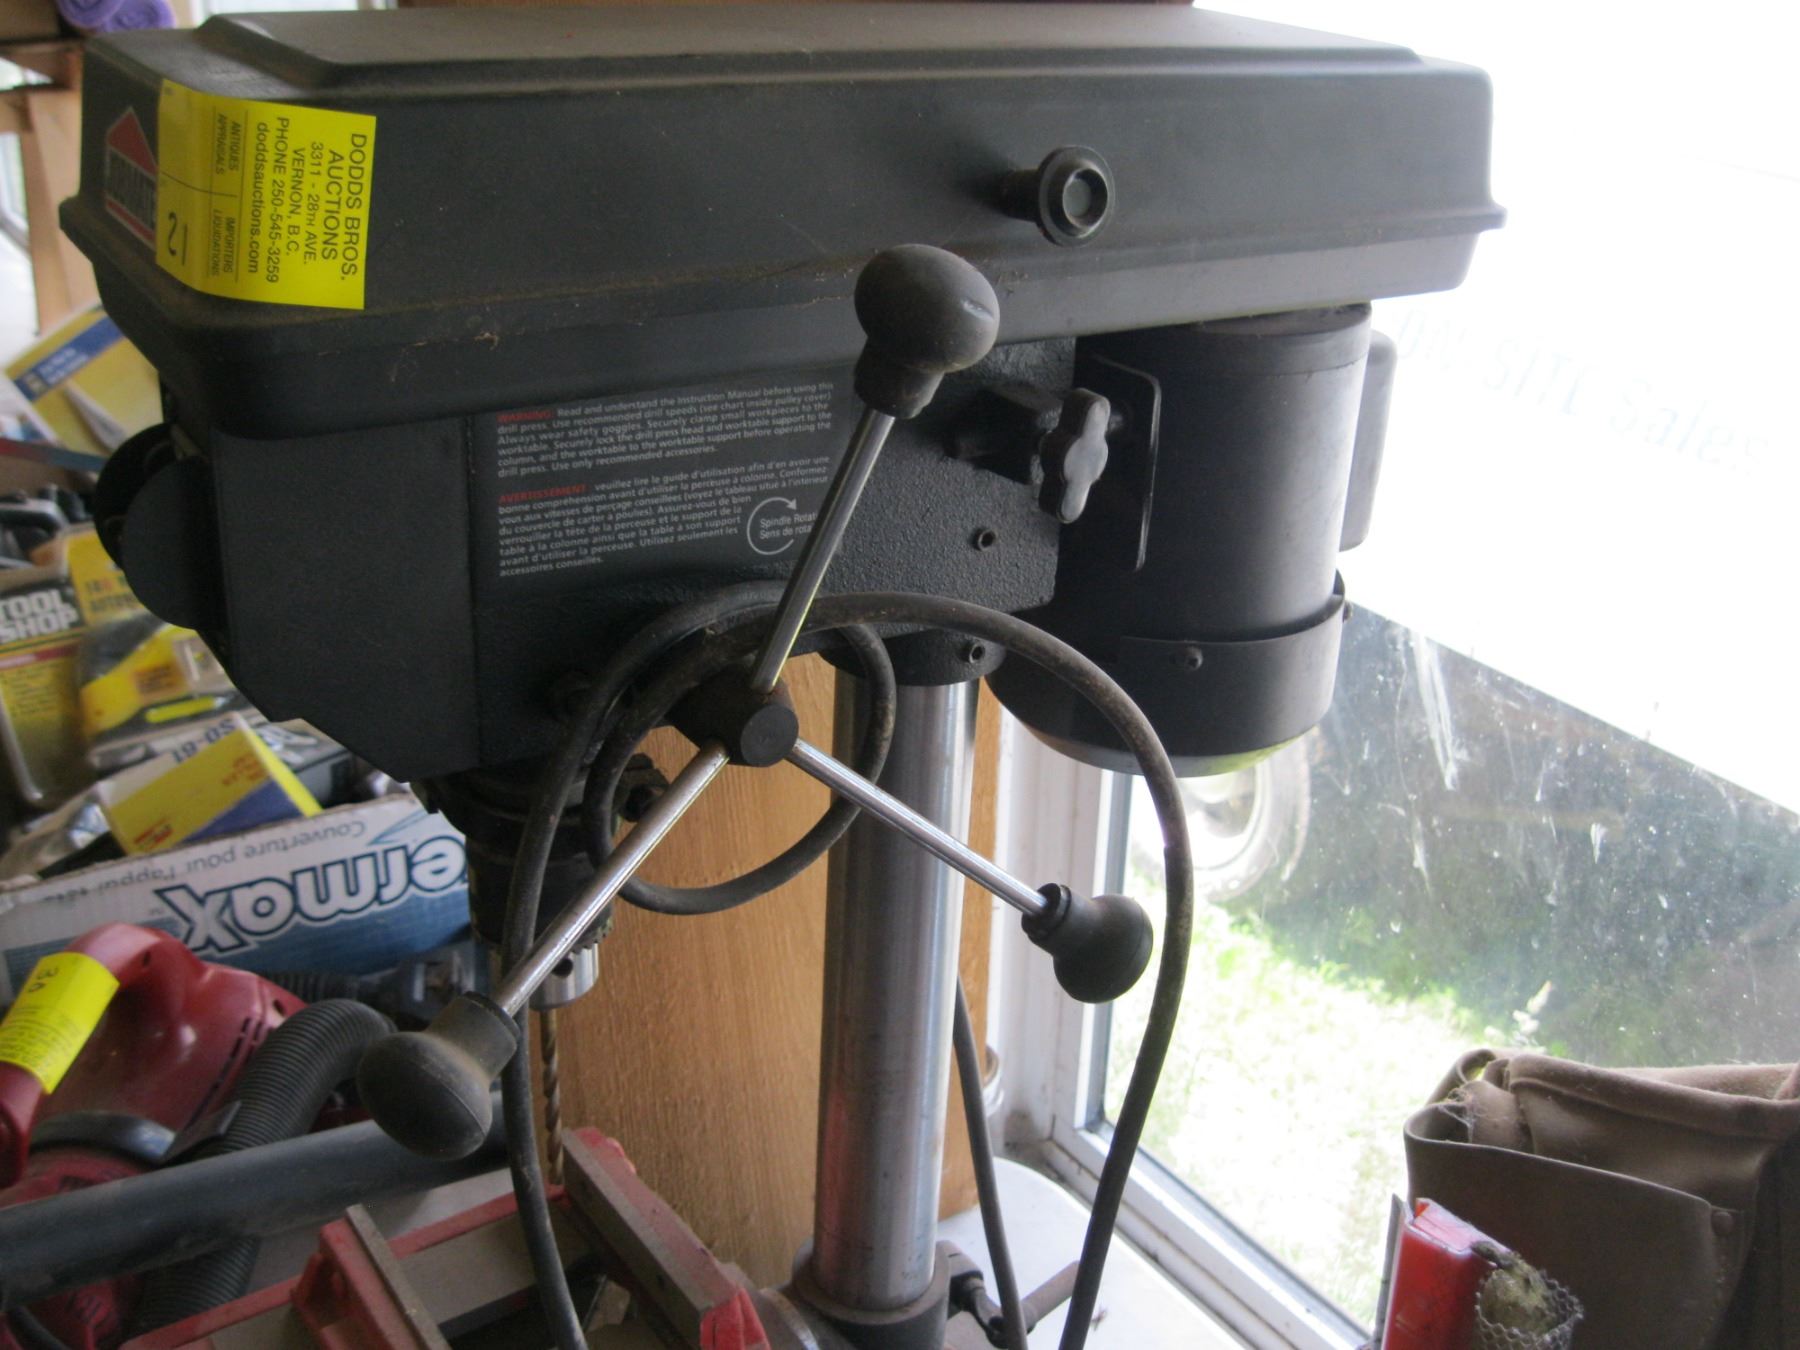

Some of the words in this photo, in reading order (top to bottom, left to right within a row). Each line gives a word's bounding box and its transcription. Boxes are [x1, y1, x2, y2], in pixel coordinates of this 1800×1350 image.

[216, 114, 228, 175] APPRAISALS
[229, 121, 241, 172] ANTIQUES
[272, 116, 290, 174] PHONE
[310, 141, 324, 176] 3311
[248, 122, 268, 274] doddsauctions.com
[288, 147, 305, 219] VERNON,
[346, 133, 368, 210] DODDS
[266, 179, 285, 283] 250-545-3259
[321, 149, 344, 261] AUCTIONS
[223, 217, 235, 273] IMPORTERS
[286, 224, 300, 256] B.C.
[303, 229, 318, 265] AVE.
[341, 215, 361, 280] BROS.
[759, 515, 791, 528] Spindle
[782, 527, 793, 536] de
[0, 588, 63, 623] TOOL
[0, 602, 79, 644] SHOP
[186, 841, 237, 873] pour
[244, 819, 366, 859] Couverture
[153, 835, 469, 955] ermax
